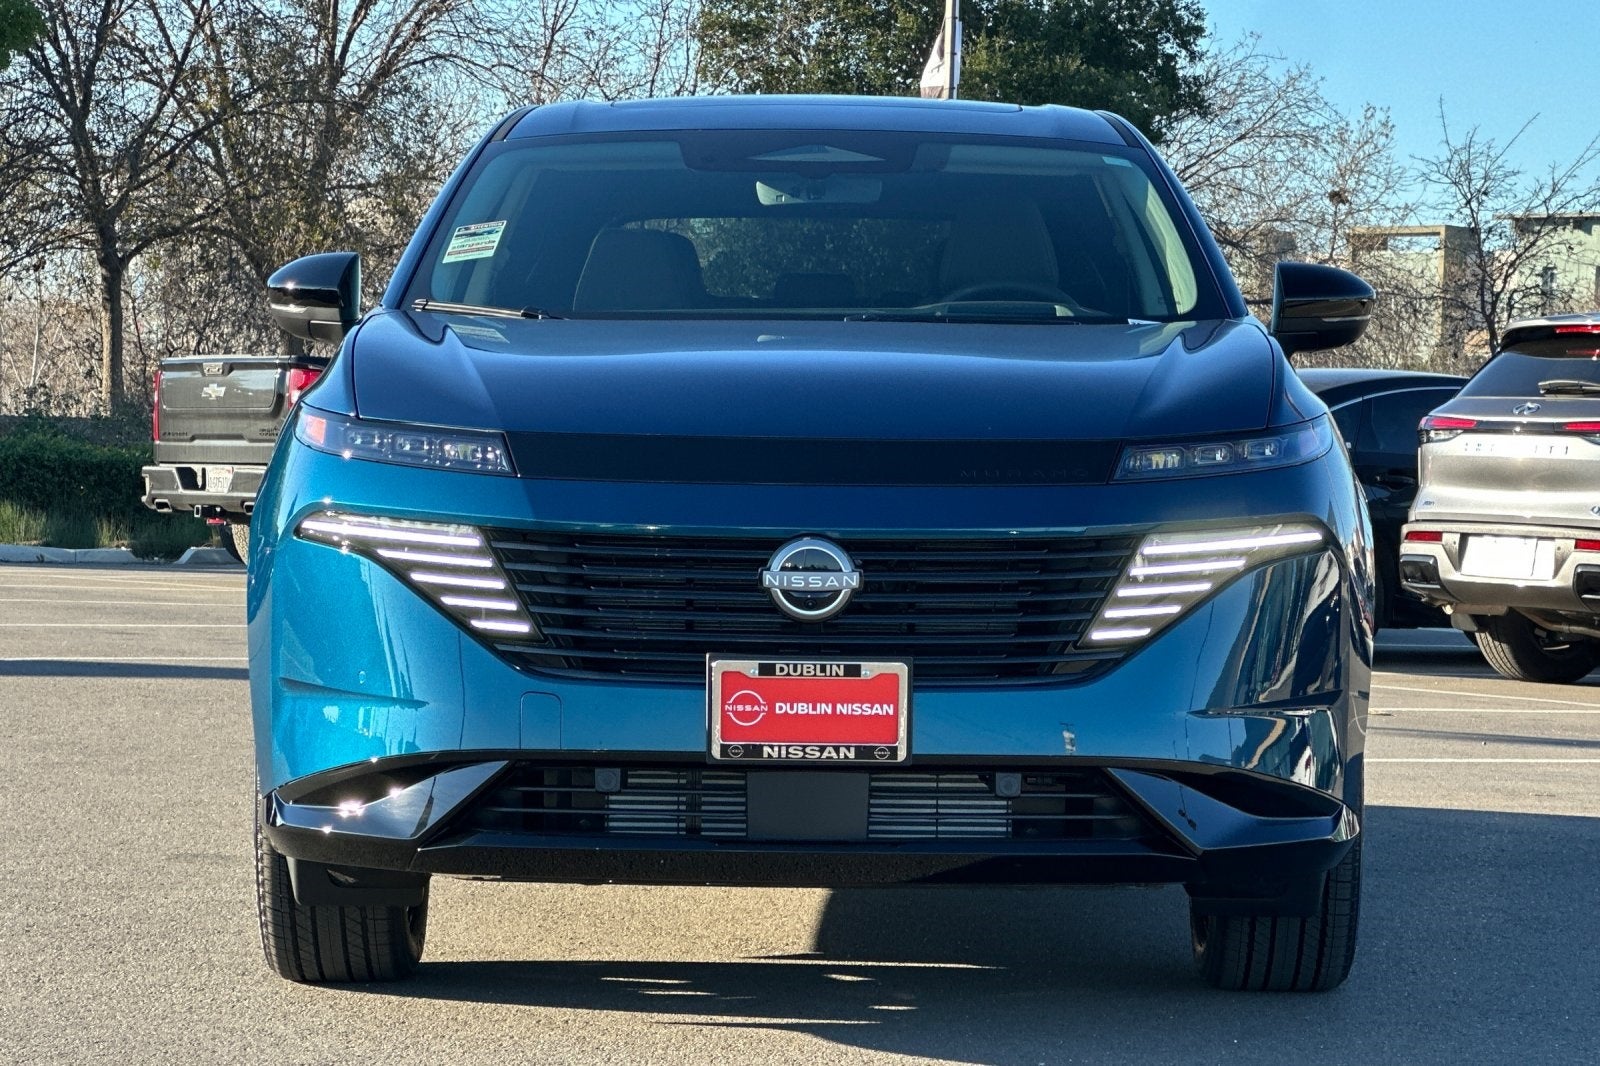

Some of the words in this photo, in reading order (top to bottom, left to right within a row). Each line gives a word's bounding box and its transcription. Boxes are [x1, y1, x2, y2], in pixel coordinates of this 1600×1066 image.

[765, 573, 857, 587] NISSAN
[775, 664, 844, 677] DUBLIN
[725, 704, 768, 712] NISSAN
[775, 702, 832, 715] DUBLIN
[836, 703, 894, 716] NISSAN
[762, 745, 855, 760] NISSAN
